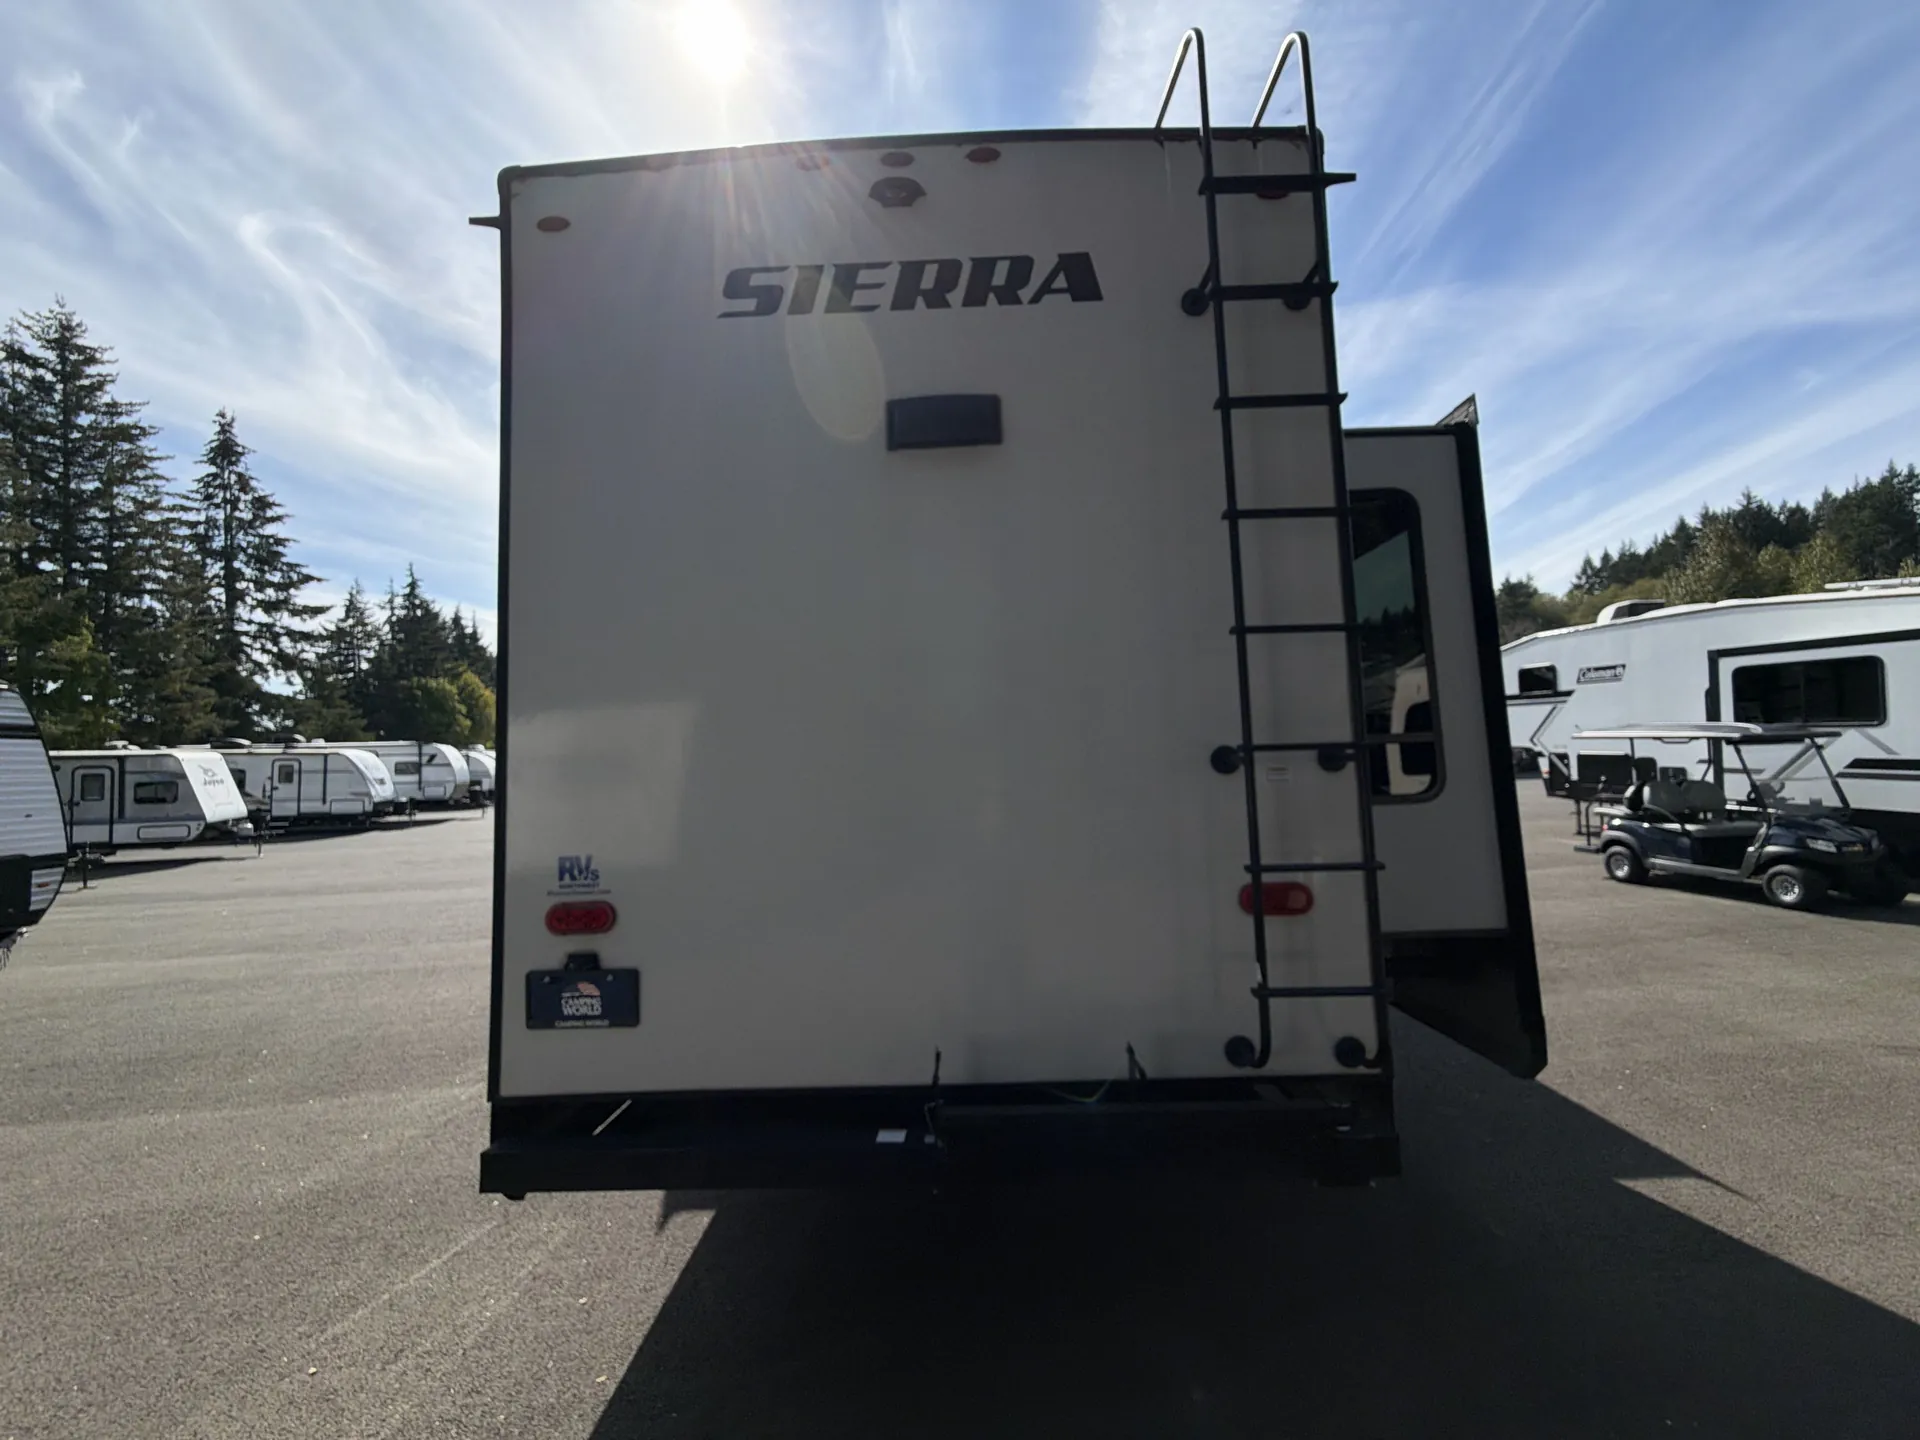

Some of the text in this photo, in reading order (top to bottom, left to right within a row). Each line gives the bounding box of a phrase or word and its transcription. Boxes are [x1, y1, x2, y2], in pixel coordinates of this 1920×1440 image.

[717, 252, 1104, 319] SIERRA
[1580, 667, 1616, 681] Coleman
[558, 855, 600, 881] RVs
[563, 1004, 602, 1016] WORLD
